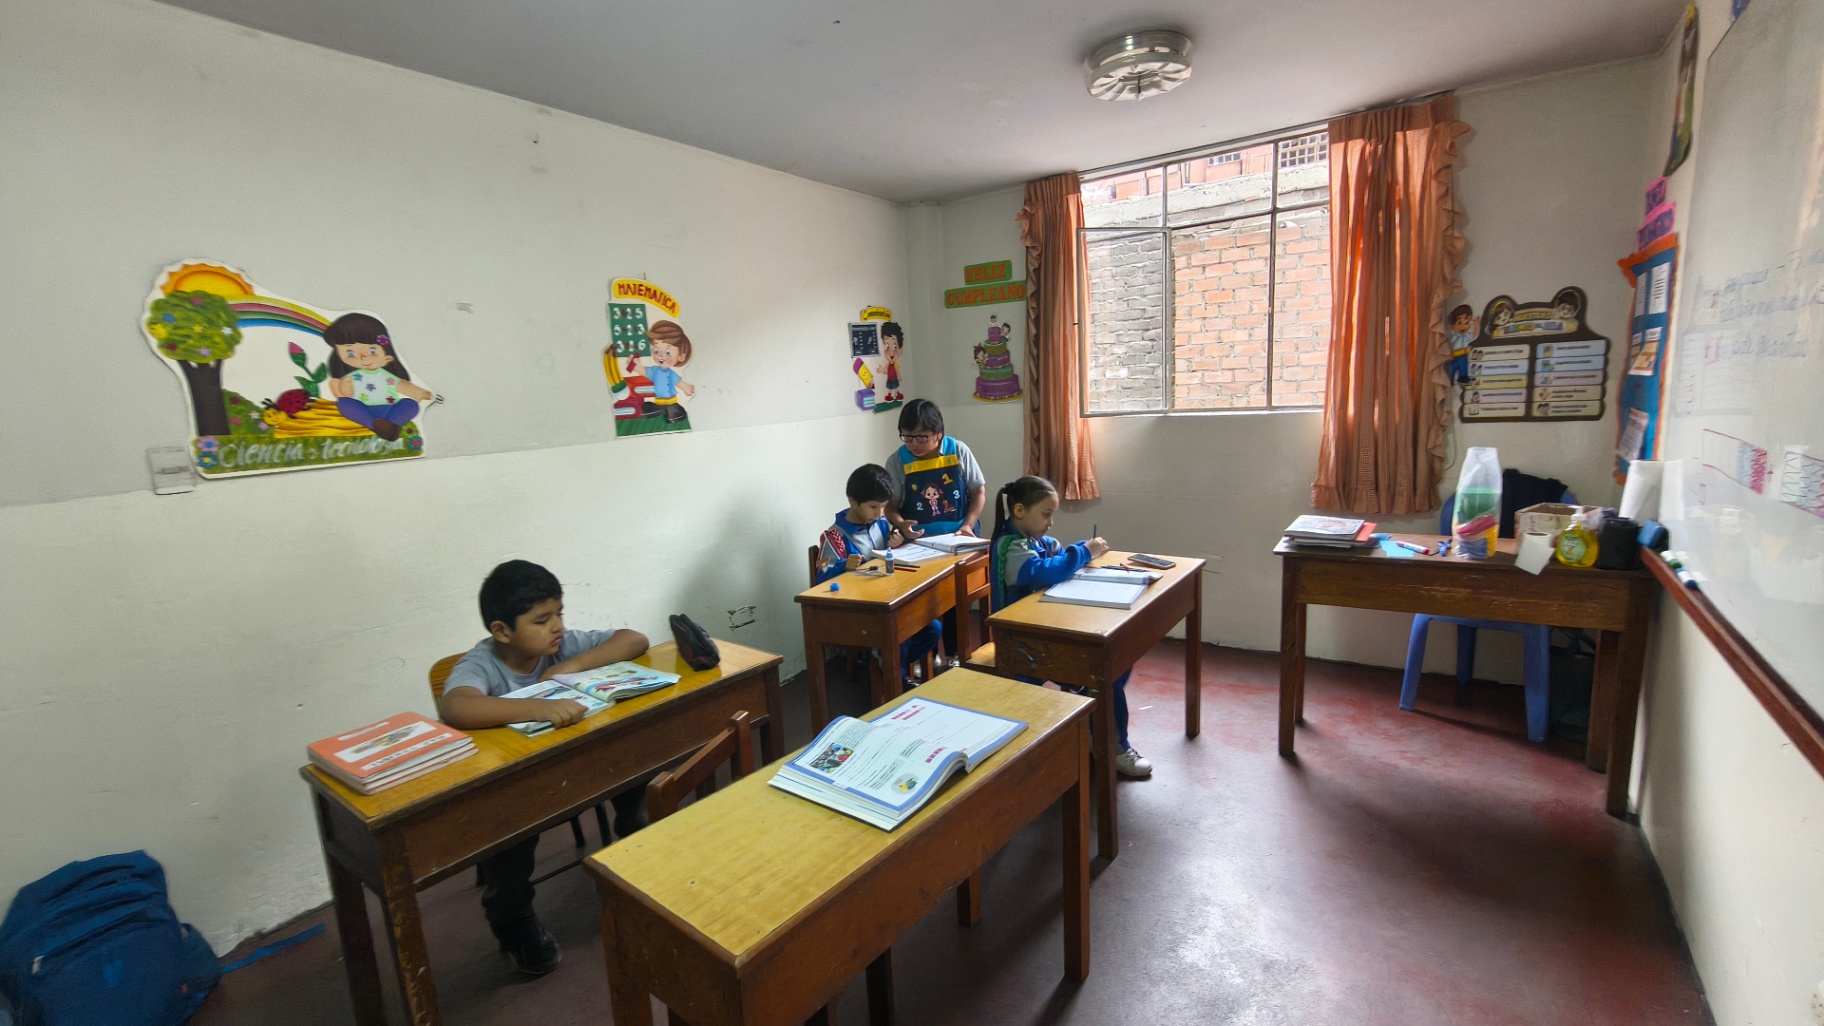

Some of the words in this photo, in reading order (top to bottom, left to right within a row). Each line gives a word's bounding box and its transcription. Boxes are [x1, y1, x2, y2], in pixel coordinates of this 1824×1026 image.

[965, 263, 1006, 283] FELIZ
[953, 490, 960, 499] 3
[916, 502, 924, 511] 2
